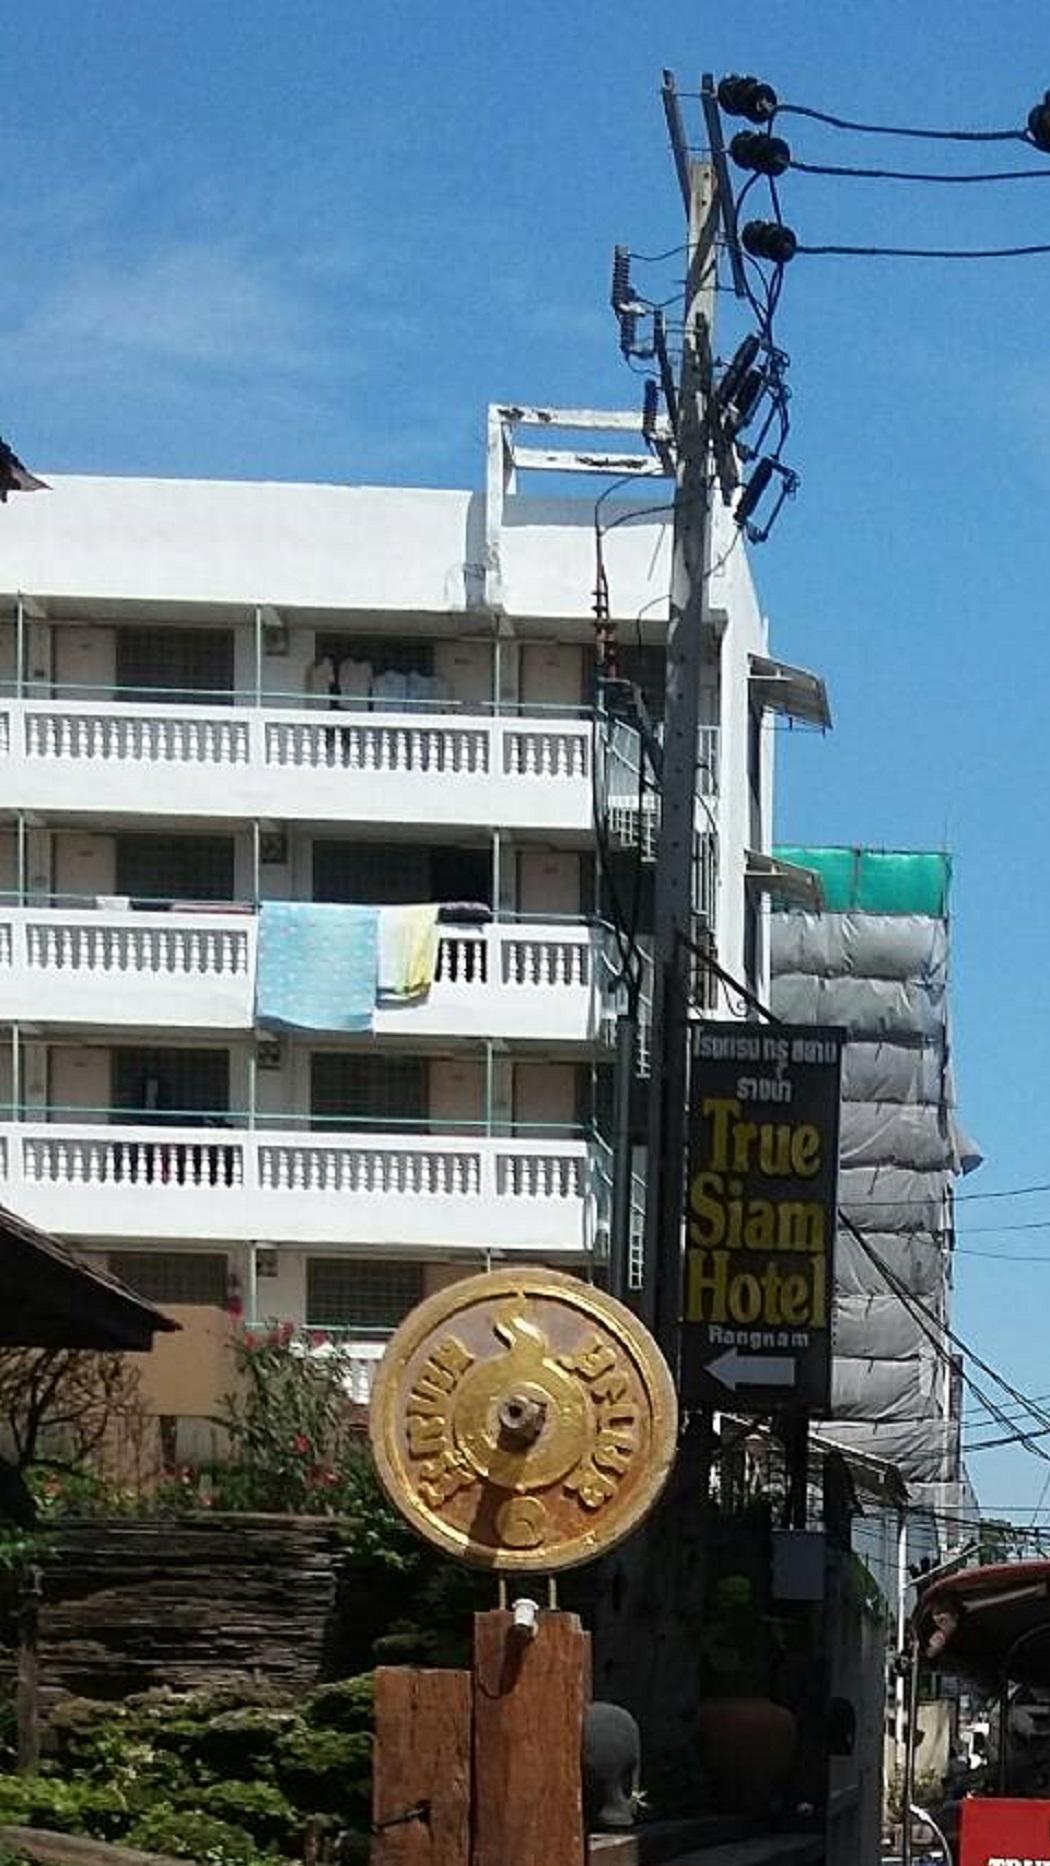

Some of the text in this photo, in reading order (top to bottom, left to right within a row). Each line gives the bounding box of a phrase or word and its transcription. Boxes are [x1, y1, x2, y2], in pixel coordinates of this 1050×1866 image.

[703, 1098, 821, 1176] True
[690, 1172, 826, 1250] Siam
[687, 1250, 826, 1328] Hotel
[708, 1325, 809, 1349] Rangnam
